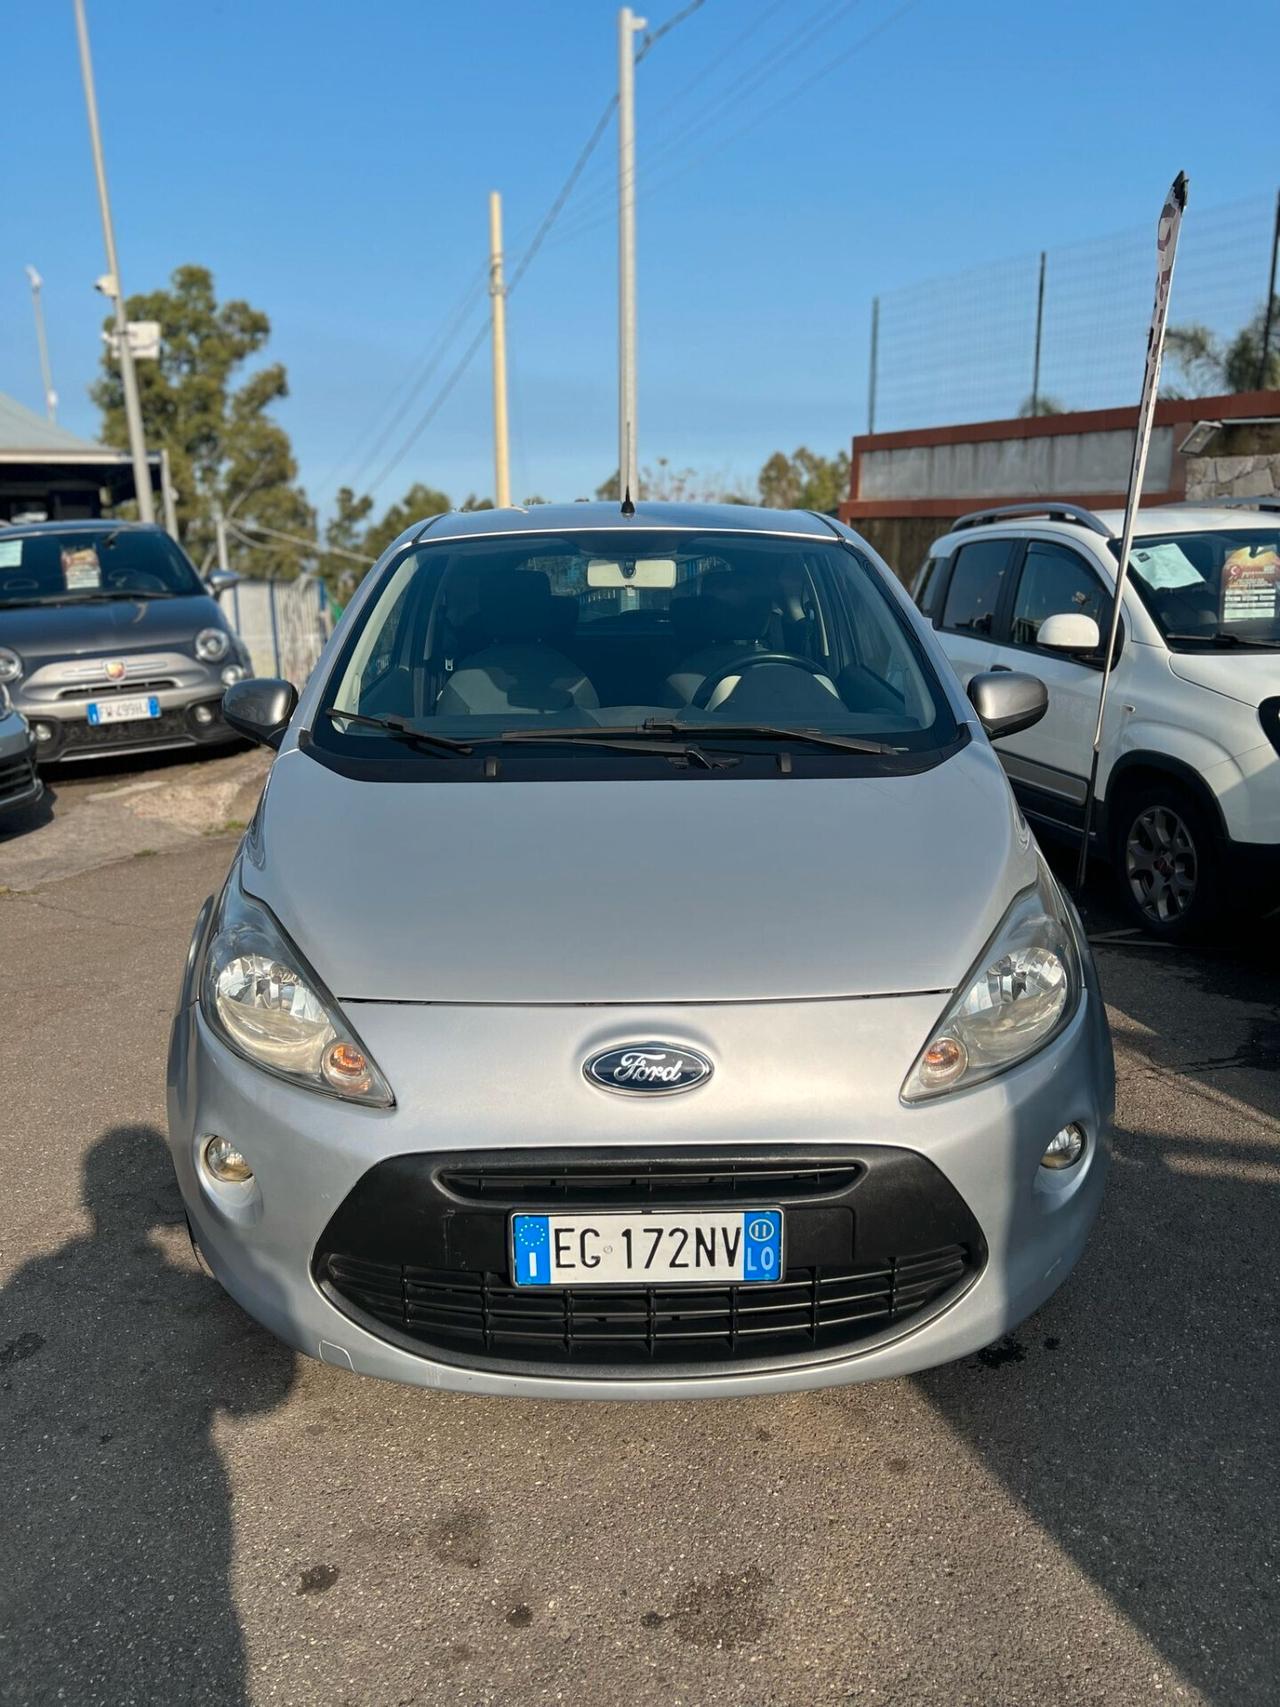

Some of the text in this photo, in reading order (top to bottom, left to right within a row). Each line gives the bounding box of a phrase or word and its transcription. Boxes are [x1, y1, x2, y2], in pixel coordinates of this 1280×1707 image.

[613, 1052, 683, 1082] Ford
[553, 1227, 742, 1270] EG 172NV
[746, 1246, 775, 1272] LO
[528, 1252, 538, 1278] I
